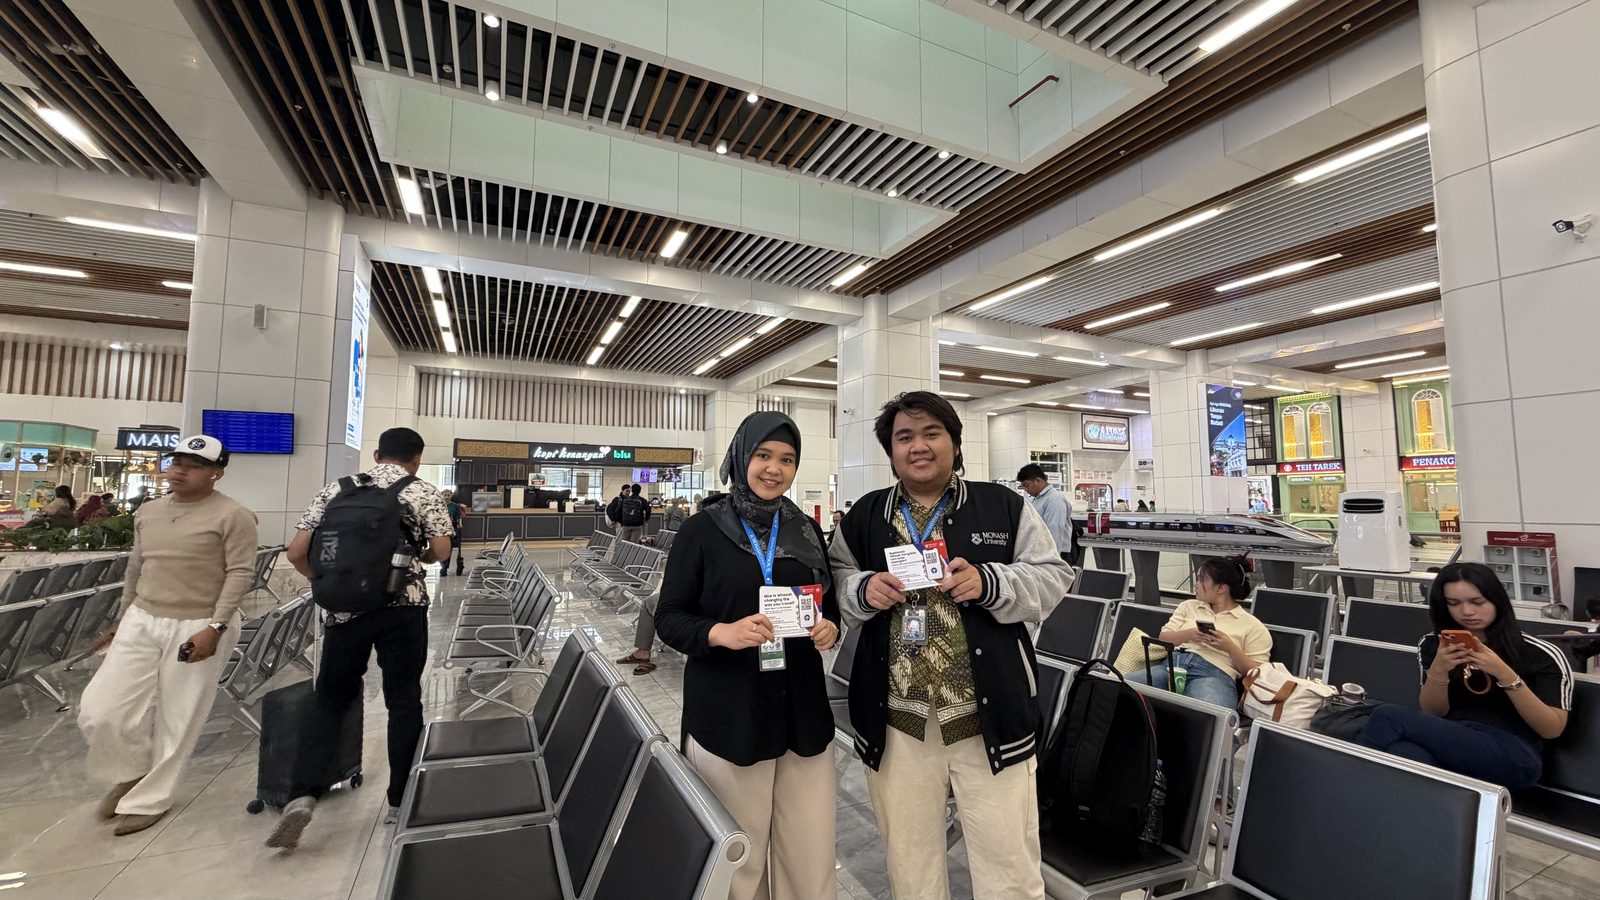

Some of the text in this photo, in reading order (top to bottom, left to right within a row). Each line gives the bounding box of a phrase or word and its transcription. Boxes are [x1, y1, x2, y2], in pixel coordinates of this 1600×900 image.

[558, 446, 604, 461] kenangan
[613, 450, 631, 458] blu
[1412, 457, 1454, 466] PENANG
[982, 532, 1008, 540] MONASH
[984, 538, 1008, 546] University
